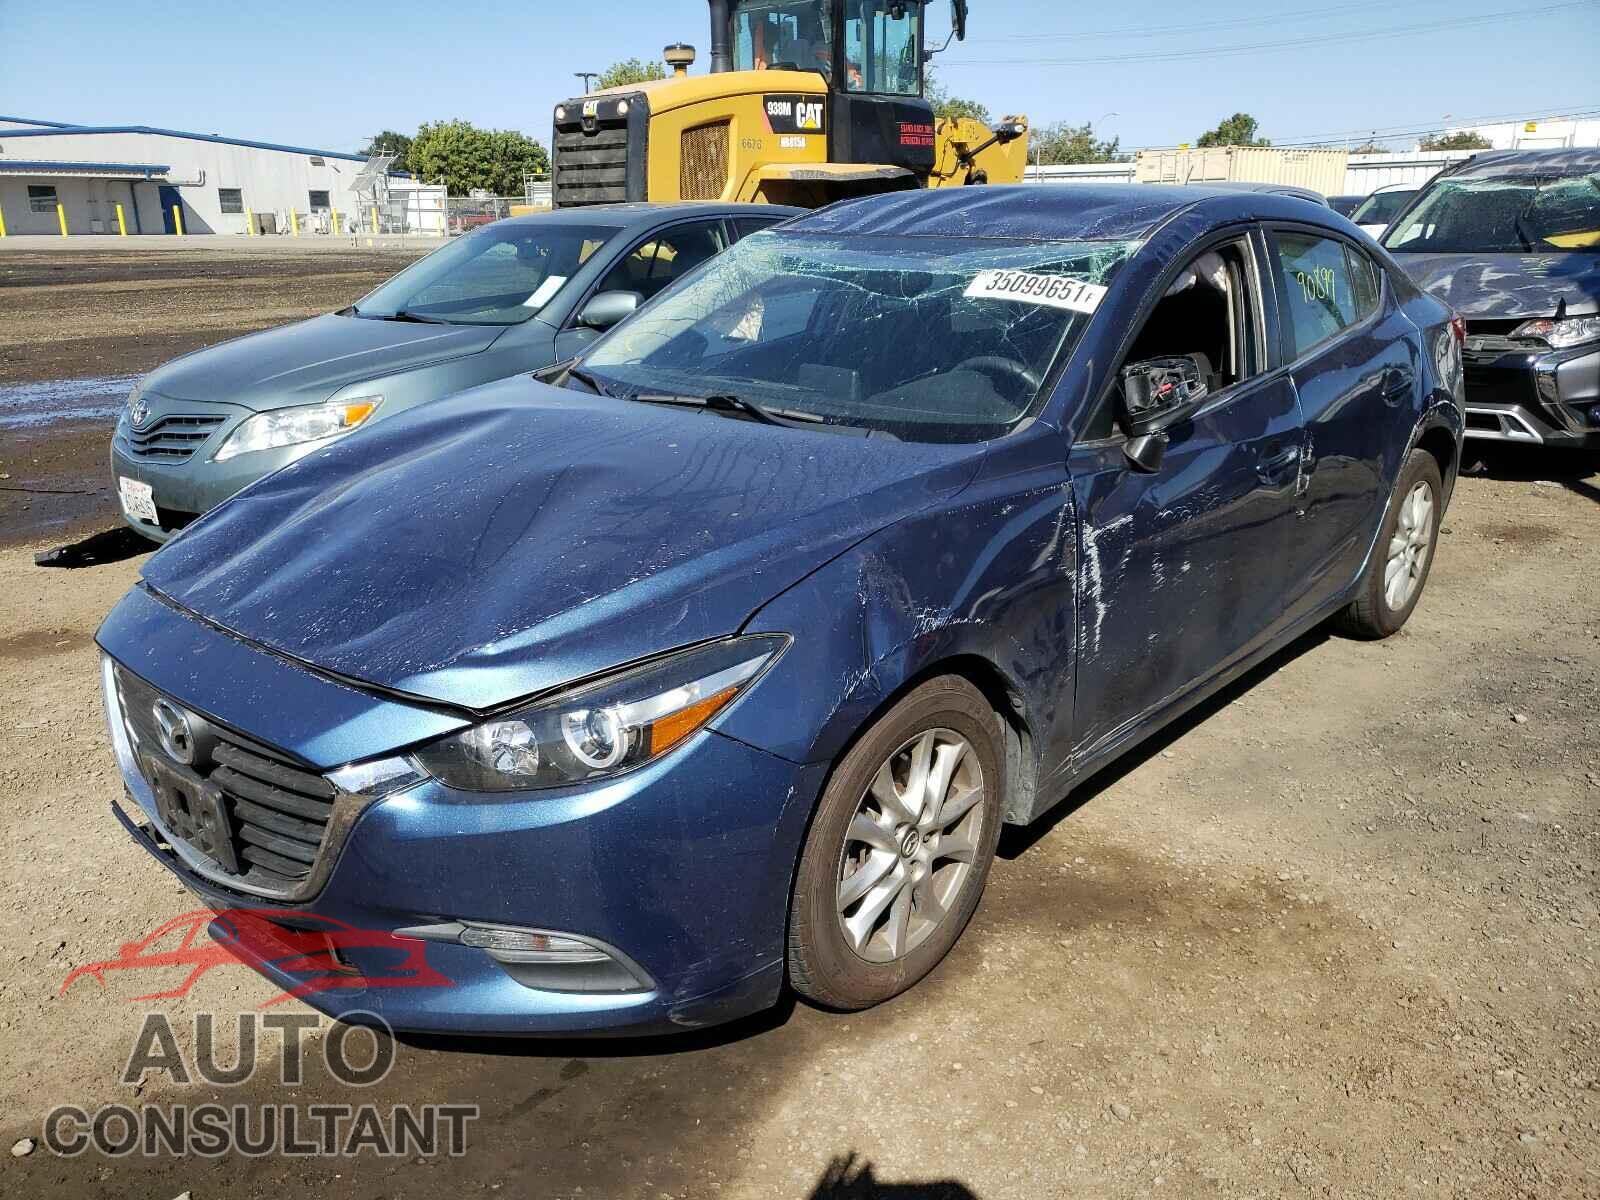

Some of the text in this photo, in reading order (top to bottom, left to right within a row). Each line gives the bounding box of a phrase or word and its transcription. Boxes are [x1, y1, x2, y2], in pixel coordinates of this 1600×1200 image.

[583, 101, 600, 117] CAT
[767, 101, 824, 129] 938M CAT
[985, 271, 1087, 303] 35099651
